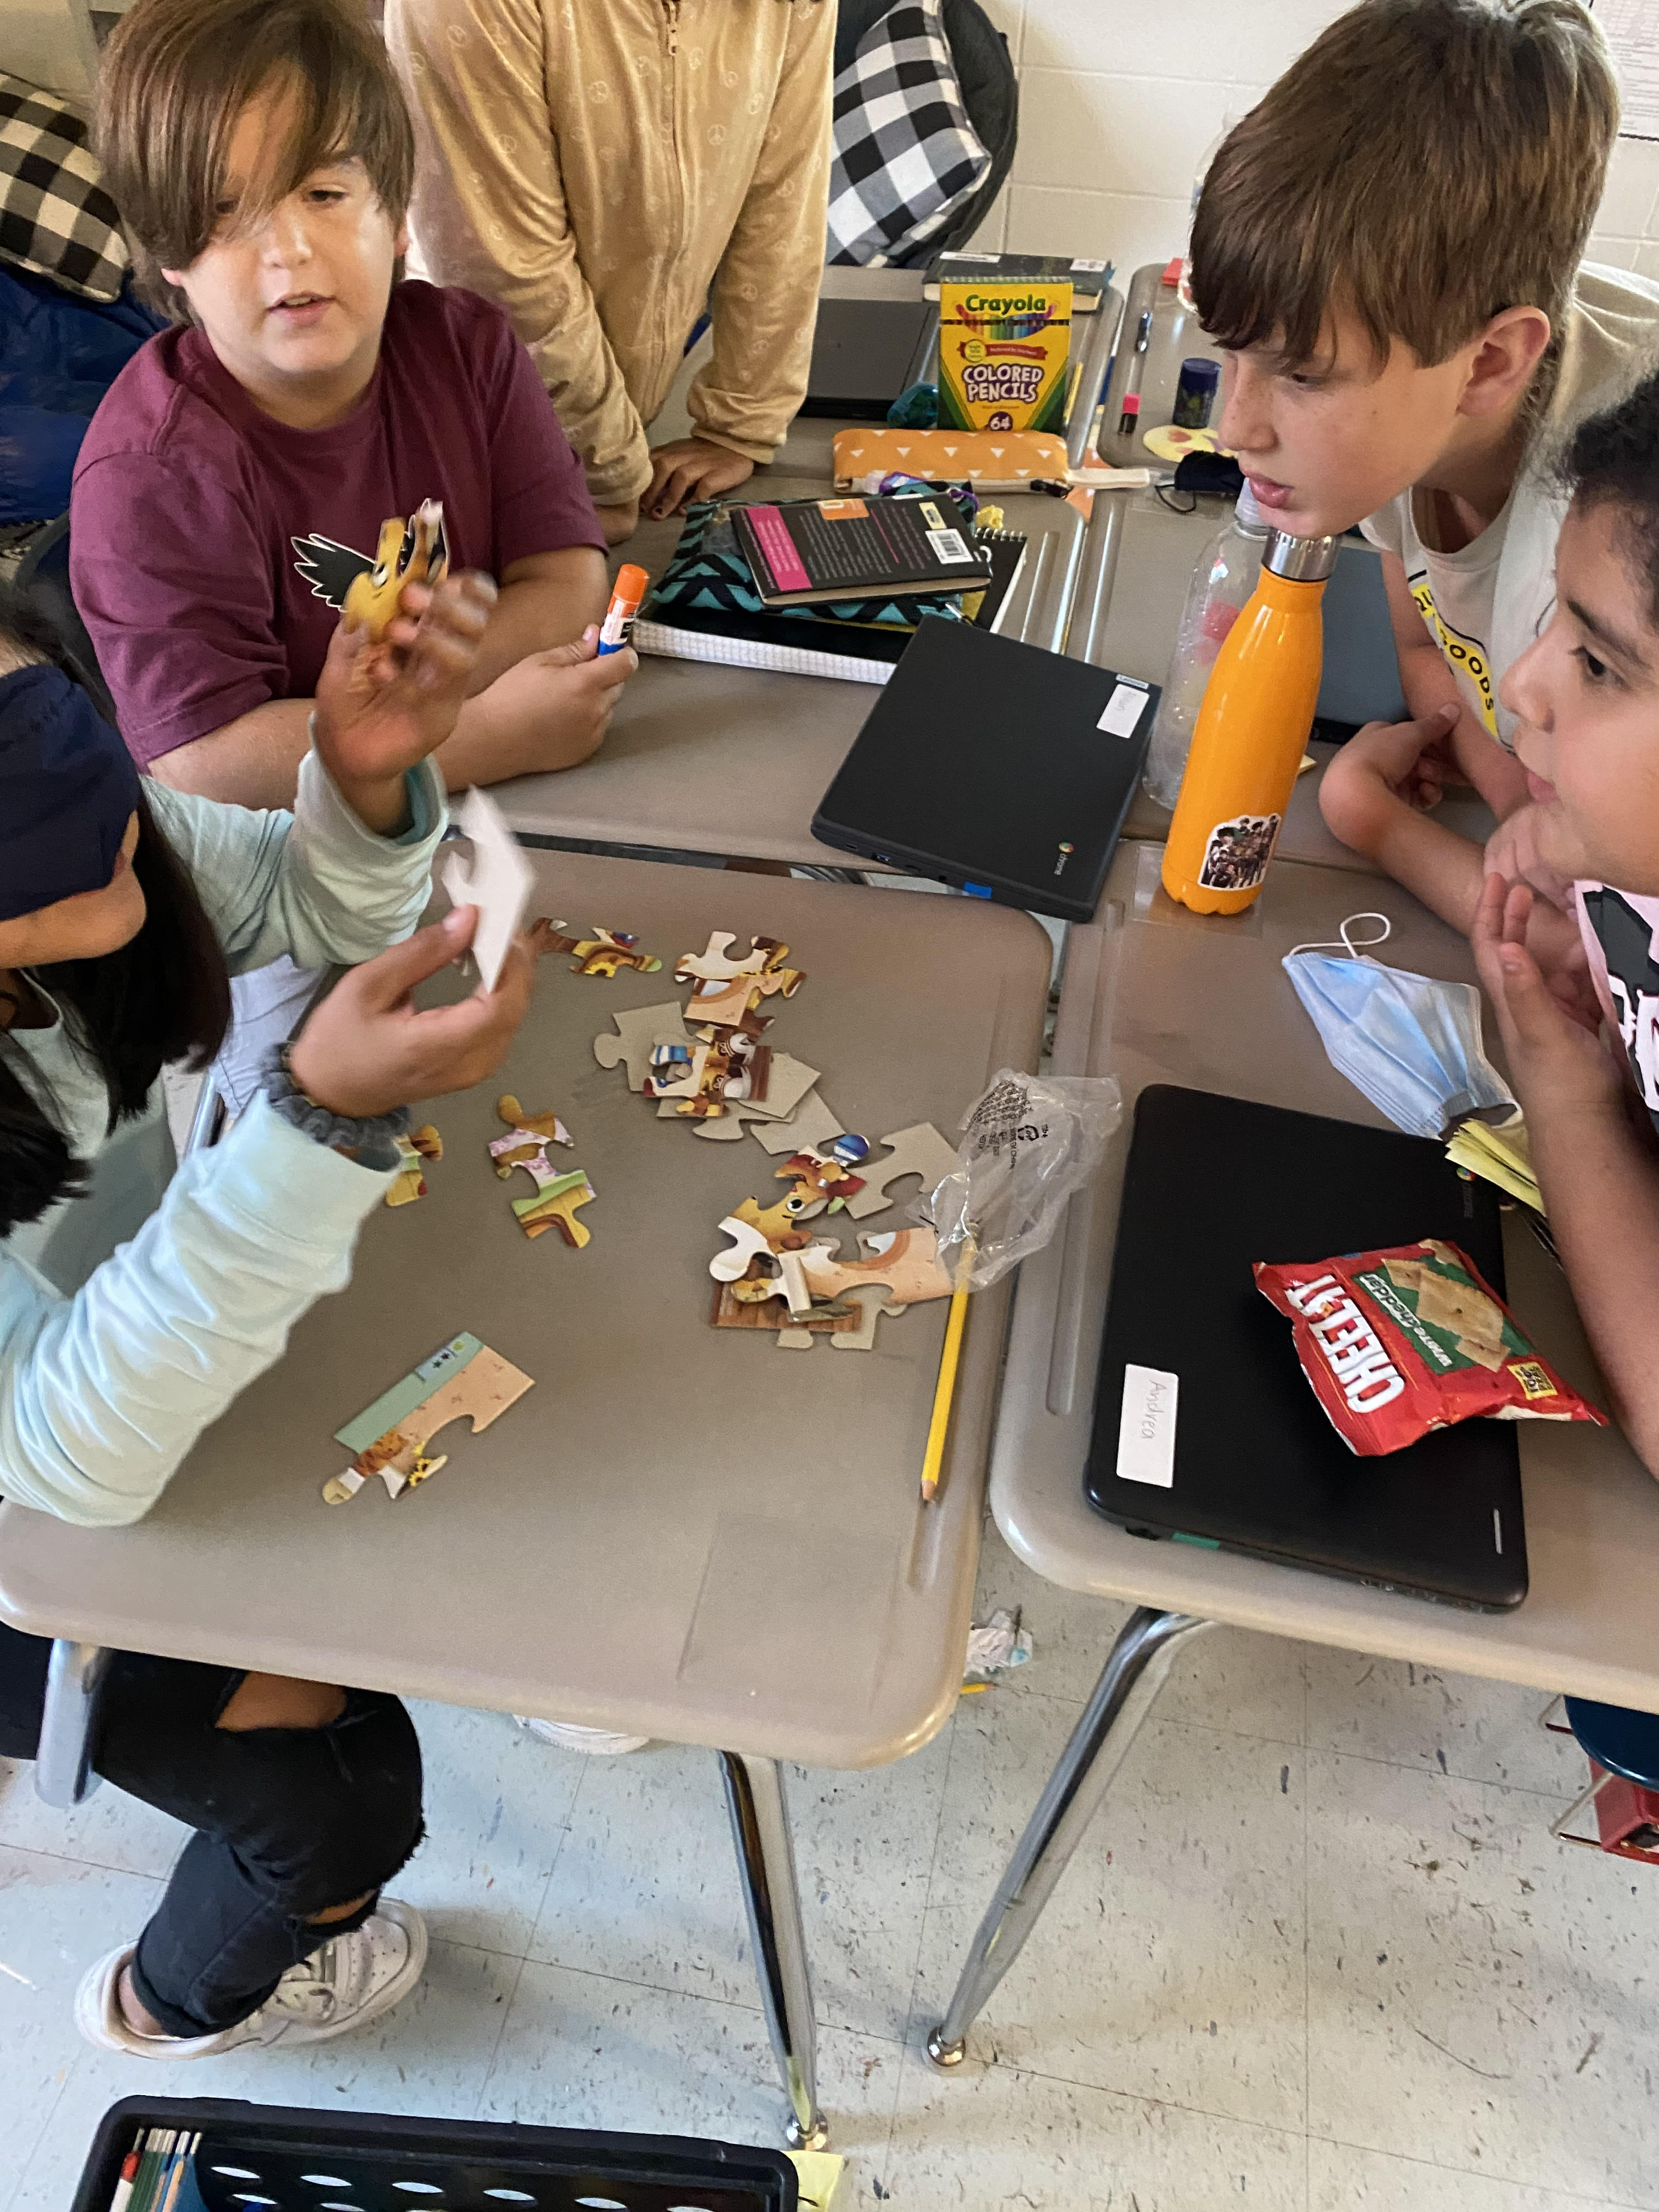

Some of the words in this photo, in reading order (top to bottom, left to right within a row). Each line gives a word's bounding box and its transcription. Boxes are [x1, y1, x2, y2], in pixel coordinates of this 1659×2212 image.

[966, 294, 1046, 316] Crayola
[963, 364, 1043, 385] COLORED
[968, 382, 1037, 403] PENCILS
[990, 416, 1010, 431] 64
[1362, 1273, 1420, 1328] cheddar
[1308, 1298, 1405, 1413] CHEEZ
[1141, 1380, 1167, 1440] Andrea
